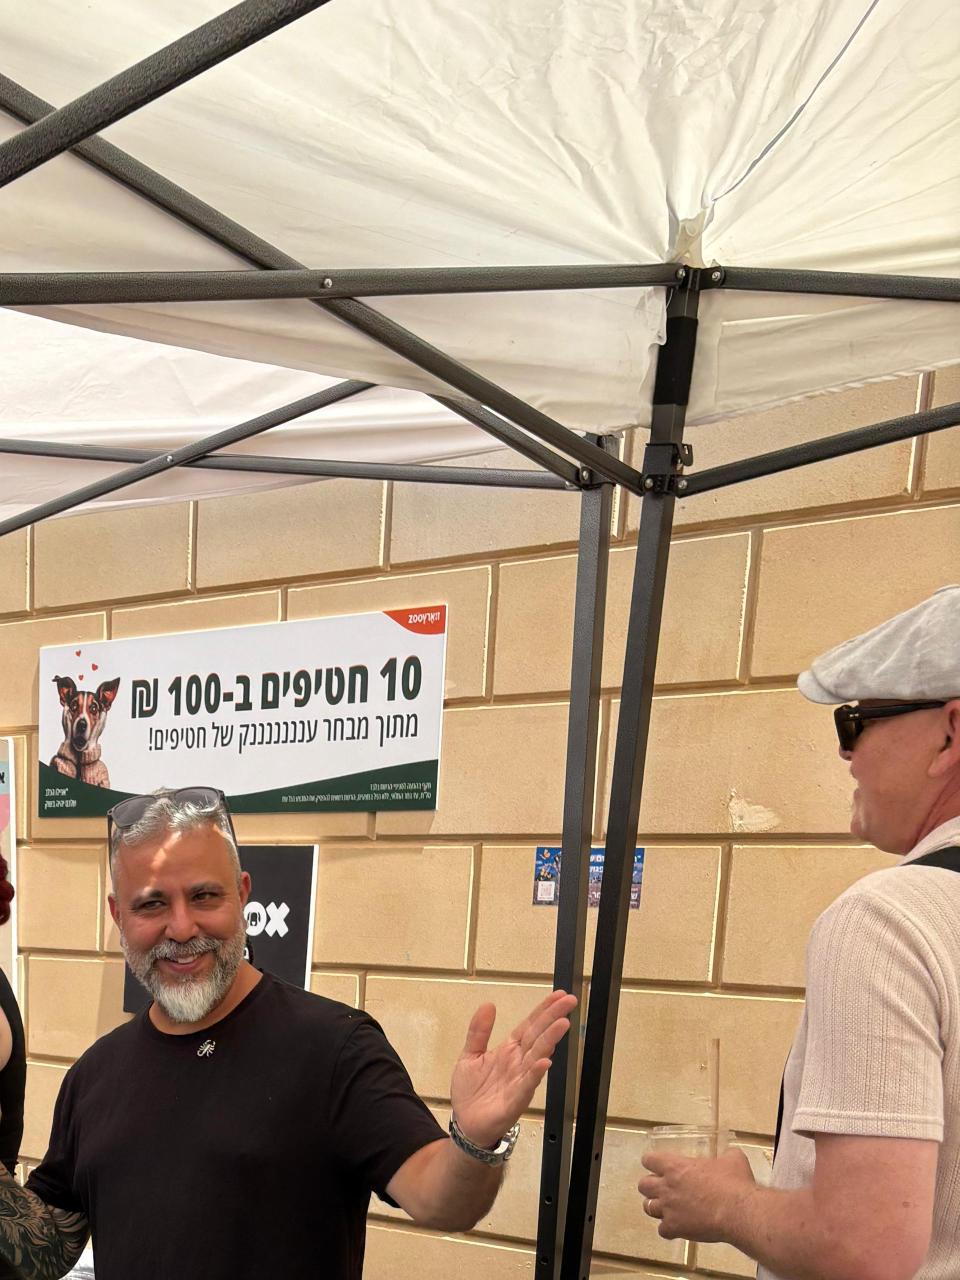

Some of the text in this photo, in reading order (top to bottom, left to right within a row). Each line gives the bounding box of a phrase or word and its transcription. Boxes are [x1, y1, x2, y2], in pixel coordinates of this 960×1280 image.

[131, 655, 423, 719] 10 חטיפים ב-100 ₪
[148, 724, 207, 752] חטיפים!
[212, 721, 234, 748] של
[323, 716, 369, 742] מבחר
[375, 711, 419, 748] מתוך
